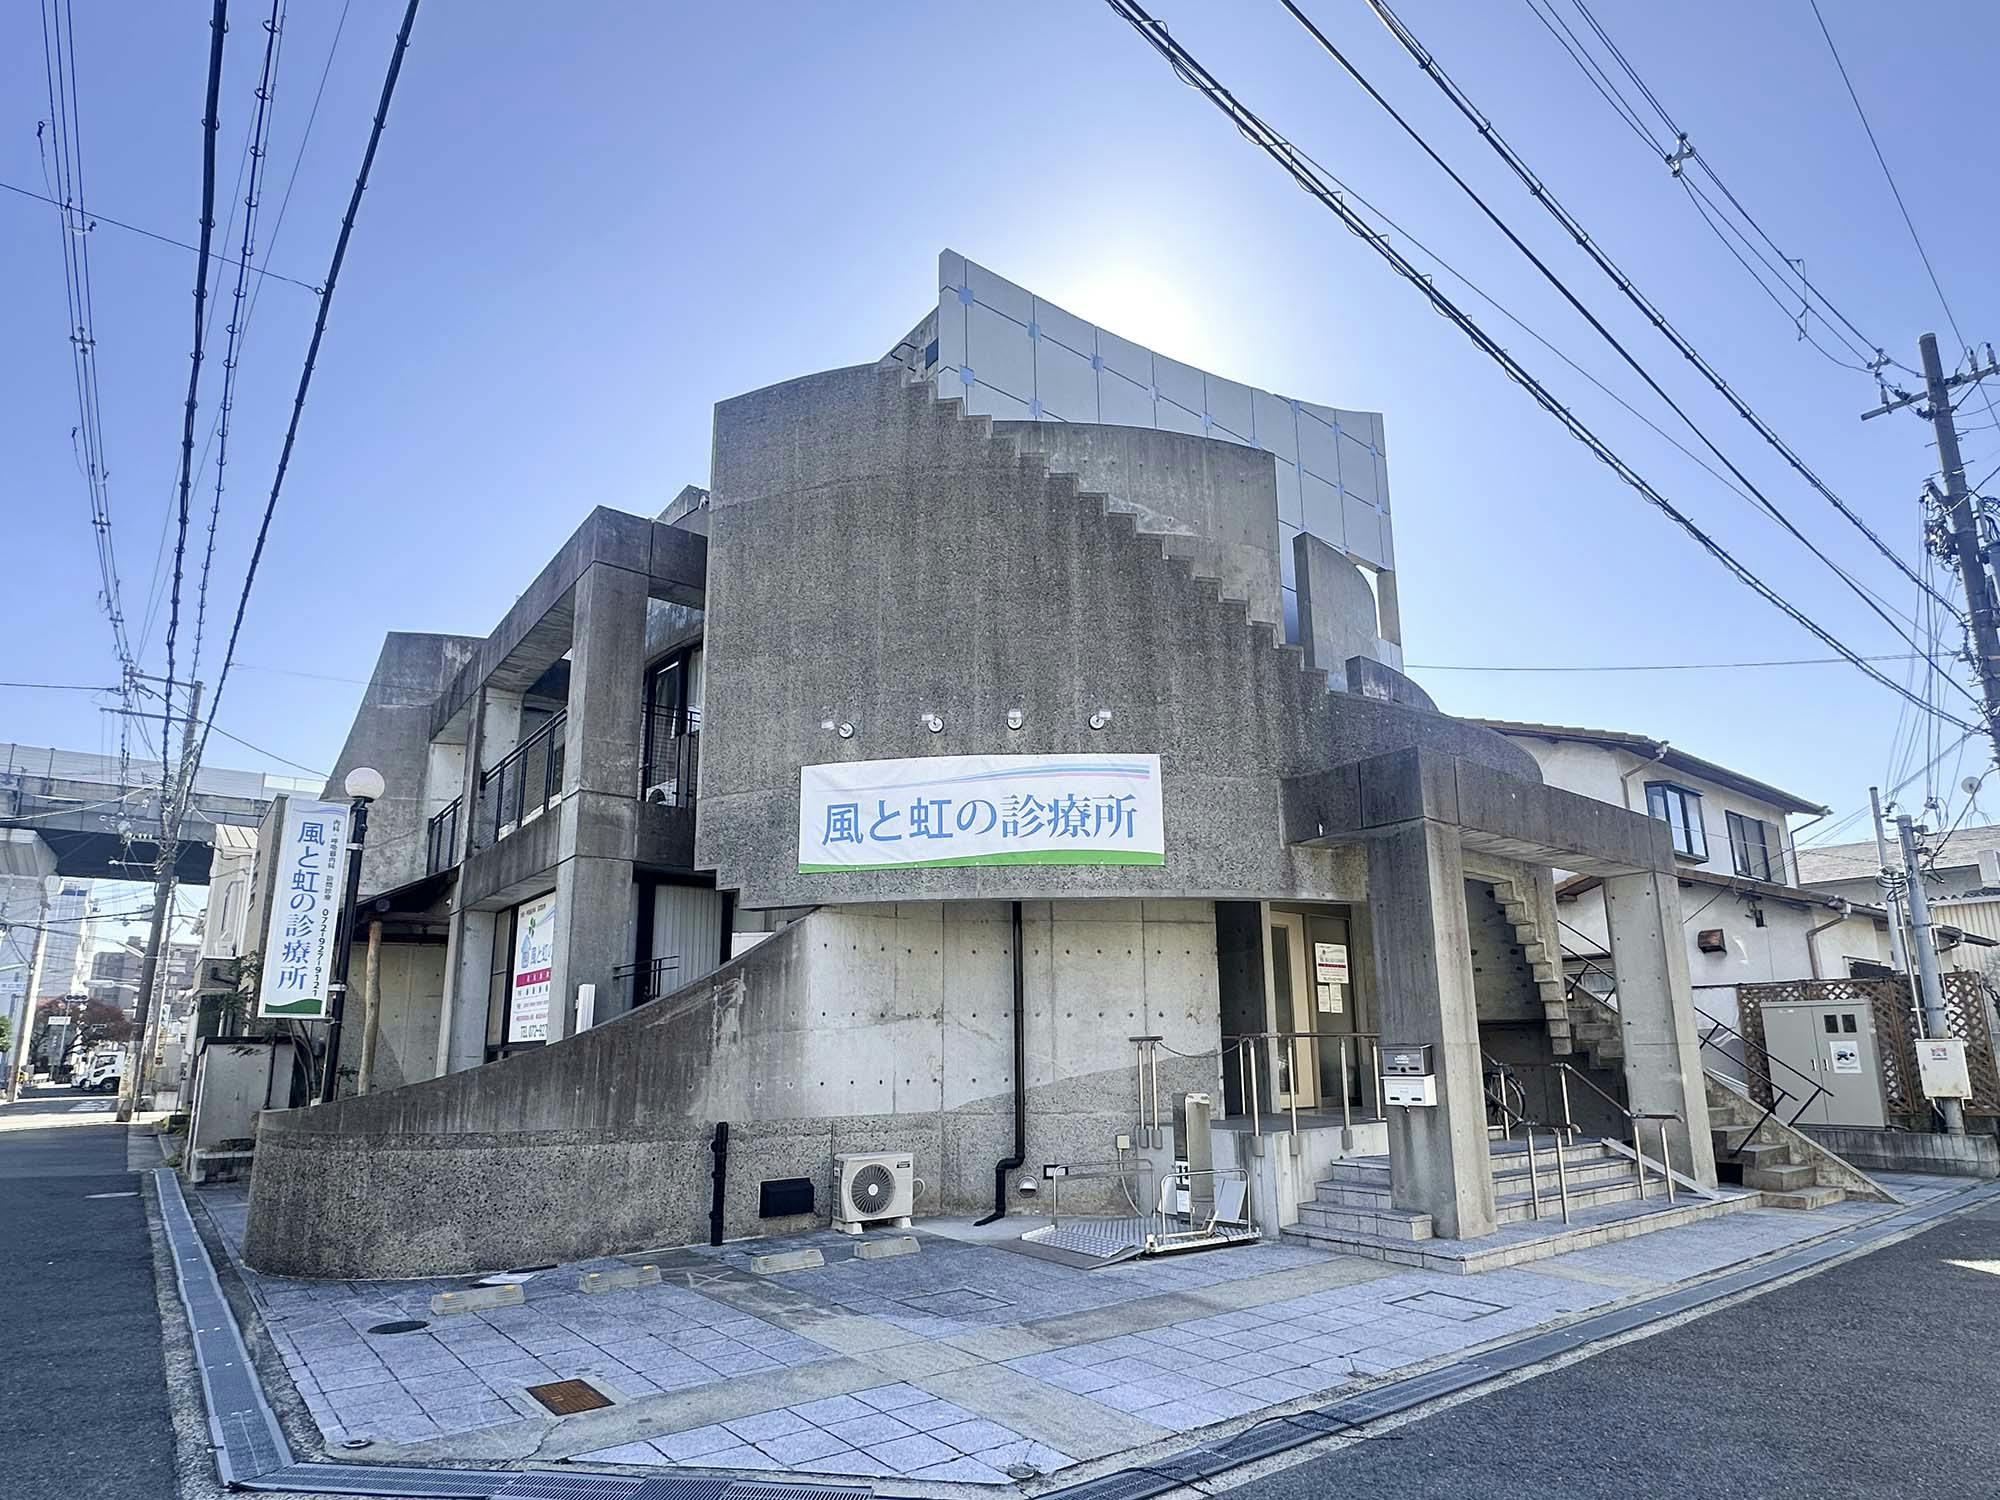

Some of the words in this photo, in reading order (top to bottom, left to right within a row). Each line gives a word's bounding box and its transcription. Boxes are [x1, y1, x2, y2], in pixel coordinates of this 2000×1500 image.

[822, 793, 1137, 846] 風と虹の診療所
[277, 821, 326, 990] 風と虹の診療所
[312, 909, 329, 997] 072-927-9121
